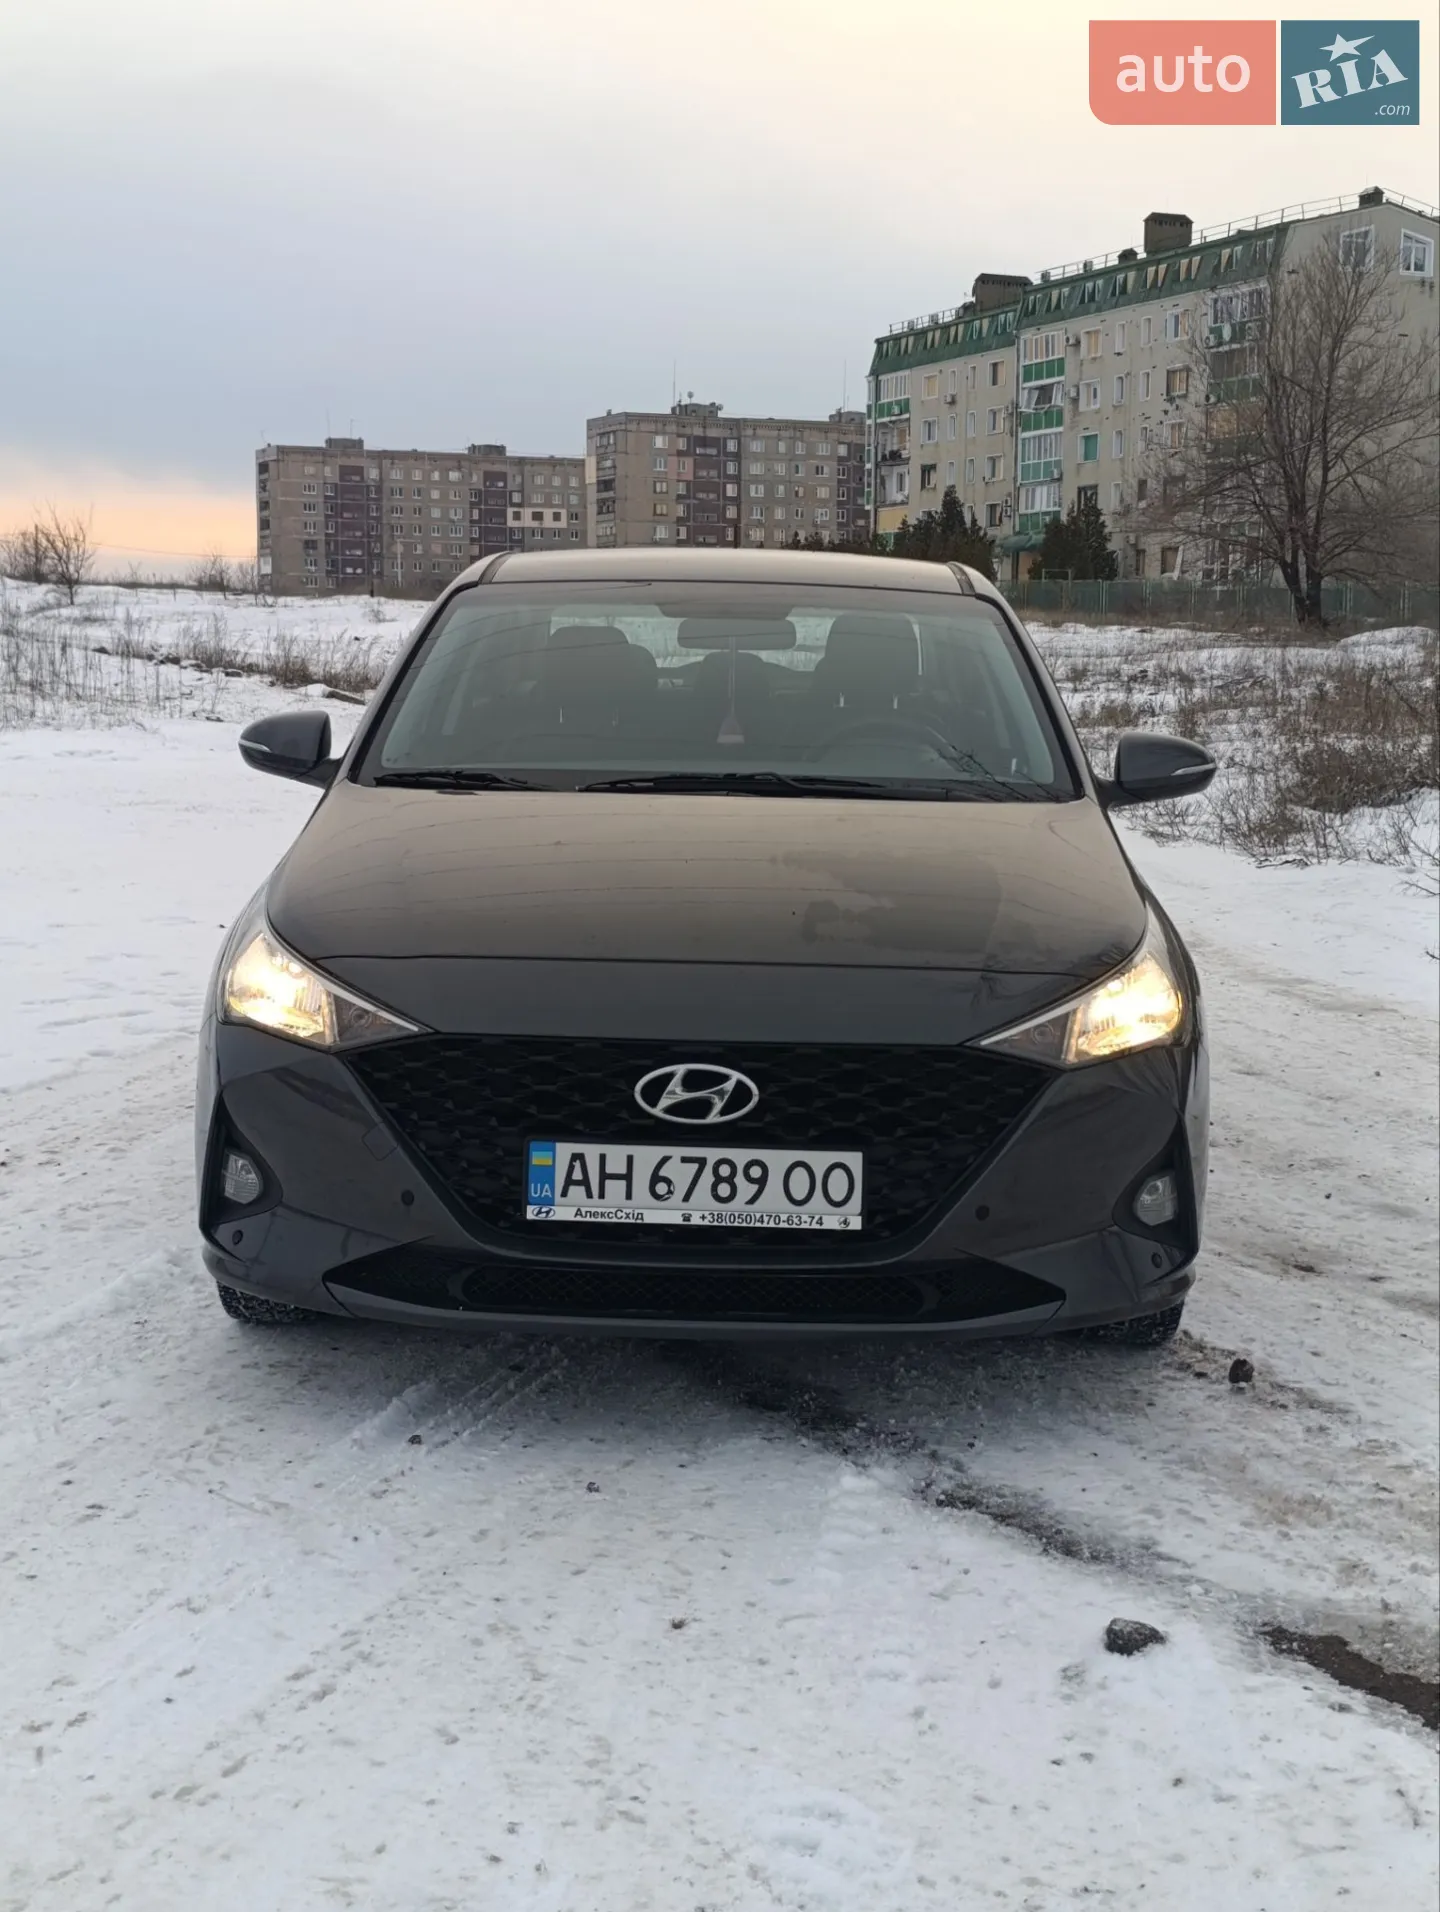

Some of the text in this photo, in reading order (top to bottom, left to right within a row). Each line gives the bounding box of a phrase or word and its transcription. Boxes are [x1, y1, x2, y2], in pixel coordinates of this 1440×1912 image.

[560, 1152, 634, 1201] AH
[648, 1155, 770, 1206] 6789
[530, 1183, 553, 1199] UA
[573, 1207, 825, 1228] АлексСхід +38(050)470-63-74
